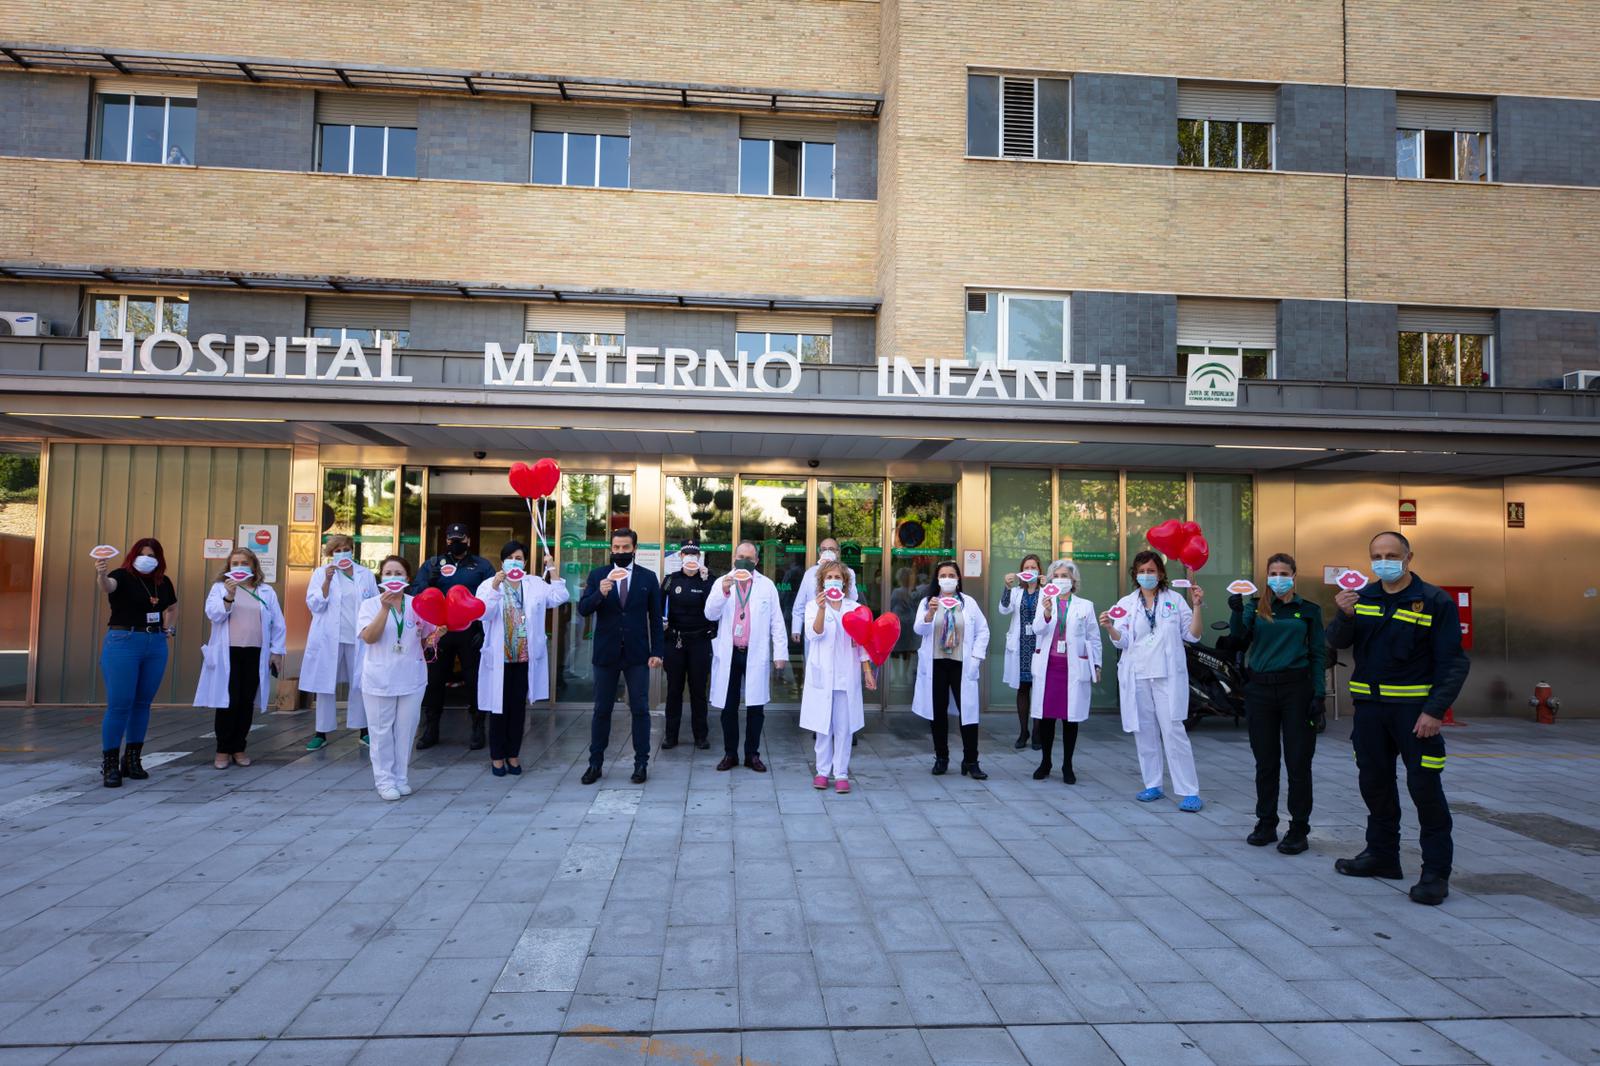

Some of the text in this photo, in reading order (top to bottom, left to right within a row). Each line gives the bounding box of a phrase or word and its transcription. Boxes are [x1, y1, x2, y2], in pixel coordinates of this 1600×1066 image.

[87, 330, 1145, 404] HOSPITAL MATERNO INFANTIL
